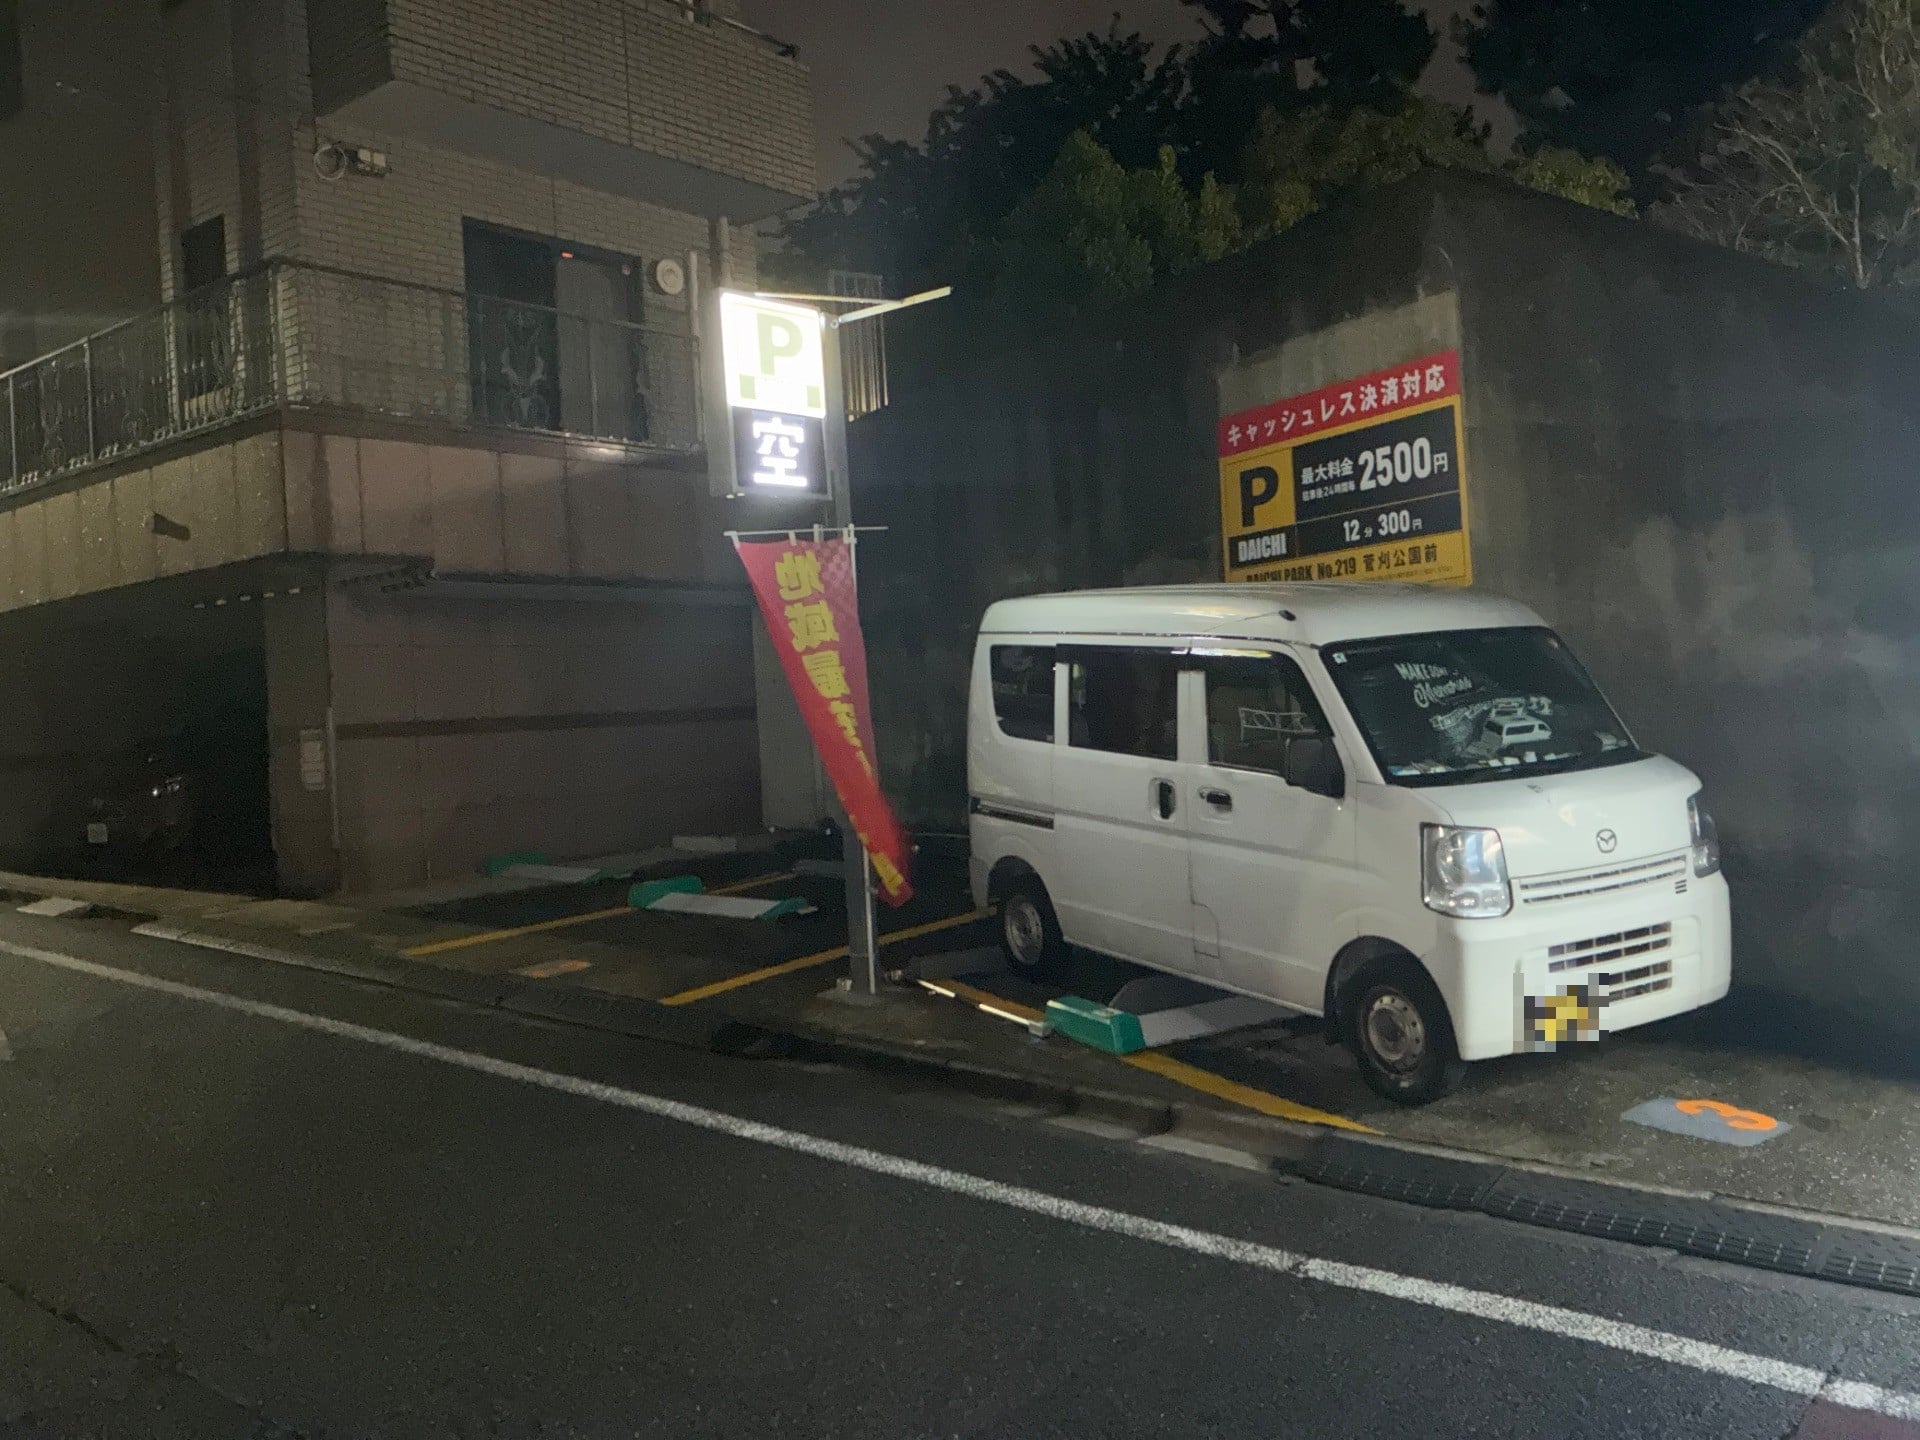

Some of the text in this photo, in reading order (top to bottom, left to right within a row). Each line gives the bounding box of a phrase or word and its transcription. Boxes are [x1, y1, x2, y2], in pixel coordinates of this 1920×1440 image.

[756, 313, 803, 376] P
[1227, 364, 1446, 447] キャッシュレス決済対応
[752, 417, 808, 487] 空
[1301, 437, 1448, 491] 最大料金 2500円
[1239, 465, 1279, 528] P
[1237, 533, 1288, 562] DAICHI
[1284, 565, 1313, 581] PARK
[1317, 557, 1357, 580] No.219
